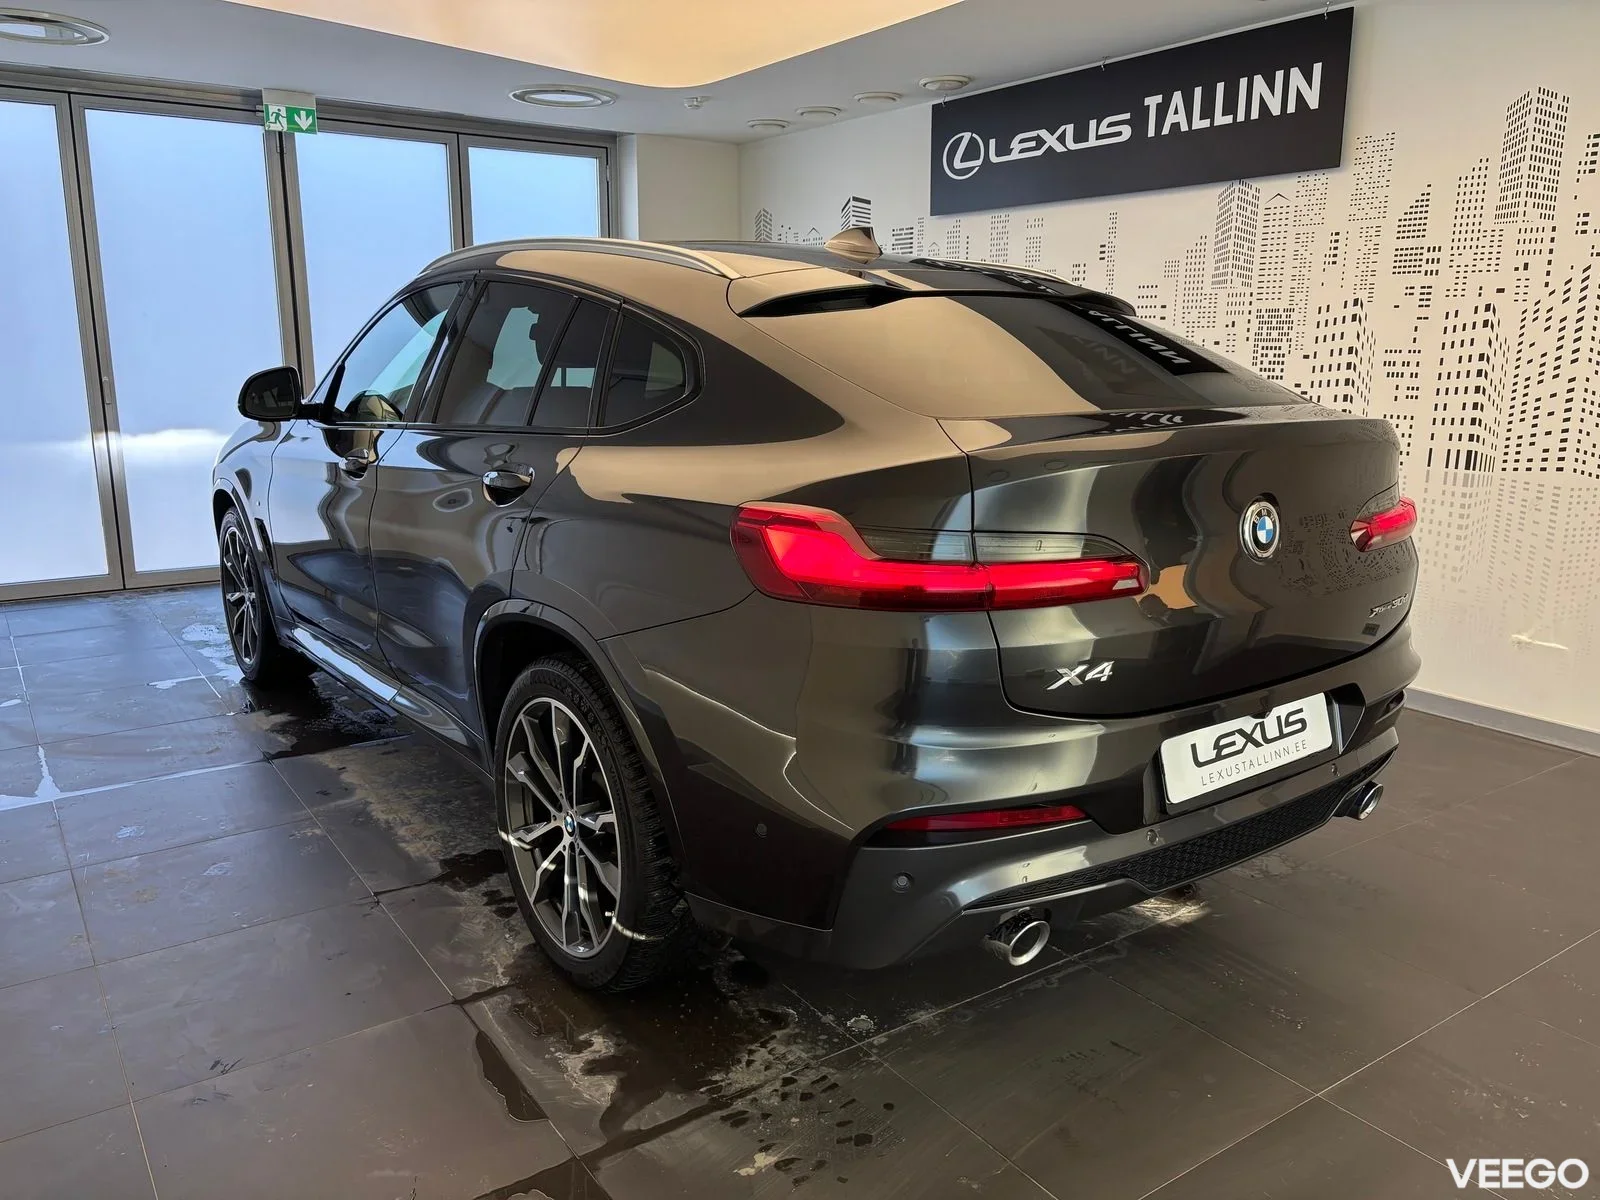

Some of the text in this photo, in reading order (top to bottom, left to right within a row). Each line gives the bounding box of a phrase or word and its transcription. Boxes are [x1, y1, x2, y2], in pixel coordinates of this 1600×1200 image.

[988, 112, 1132, 164] LEXUS
[1144, 62, 1323, 138] TALLINN
[1046, 660, 1115, 690] X4
[1190, 707, 1308, 769] LEXUS
[1201, 739, 1308, 787] LEXUSTALLINN.EE
